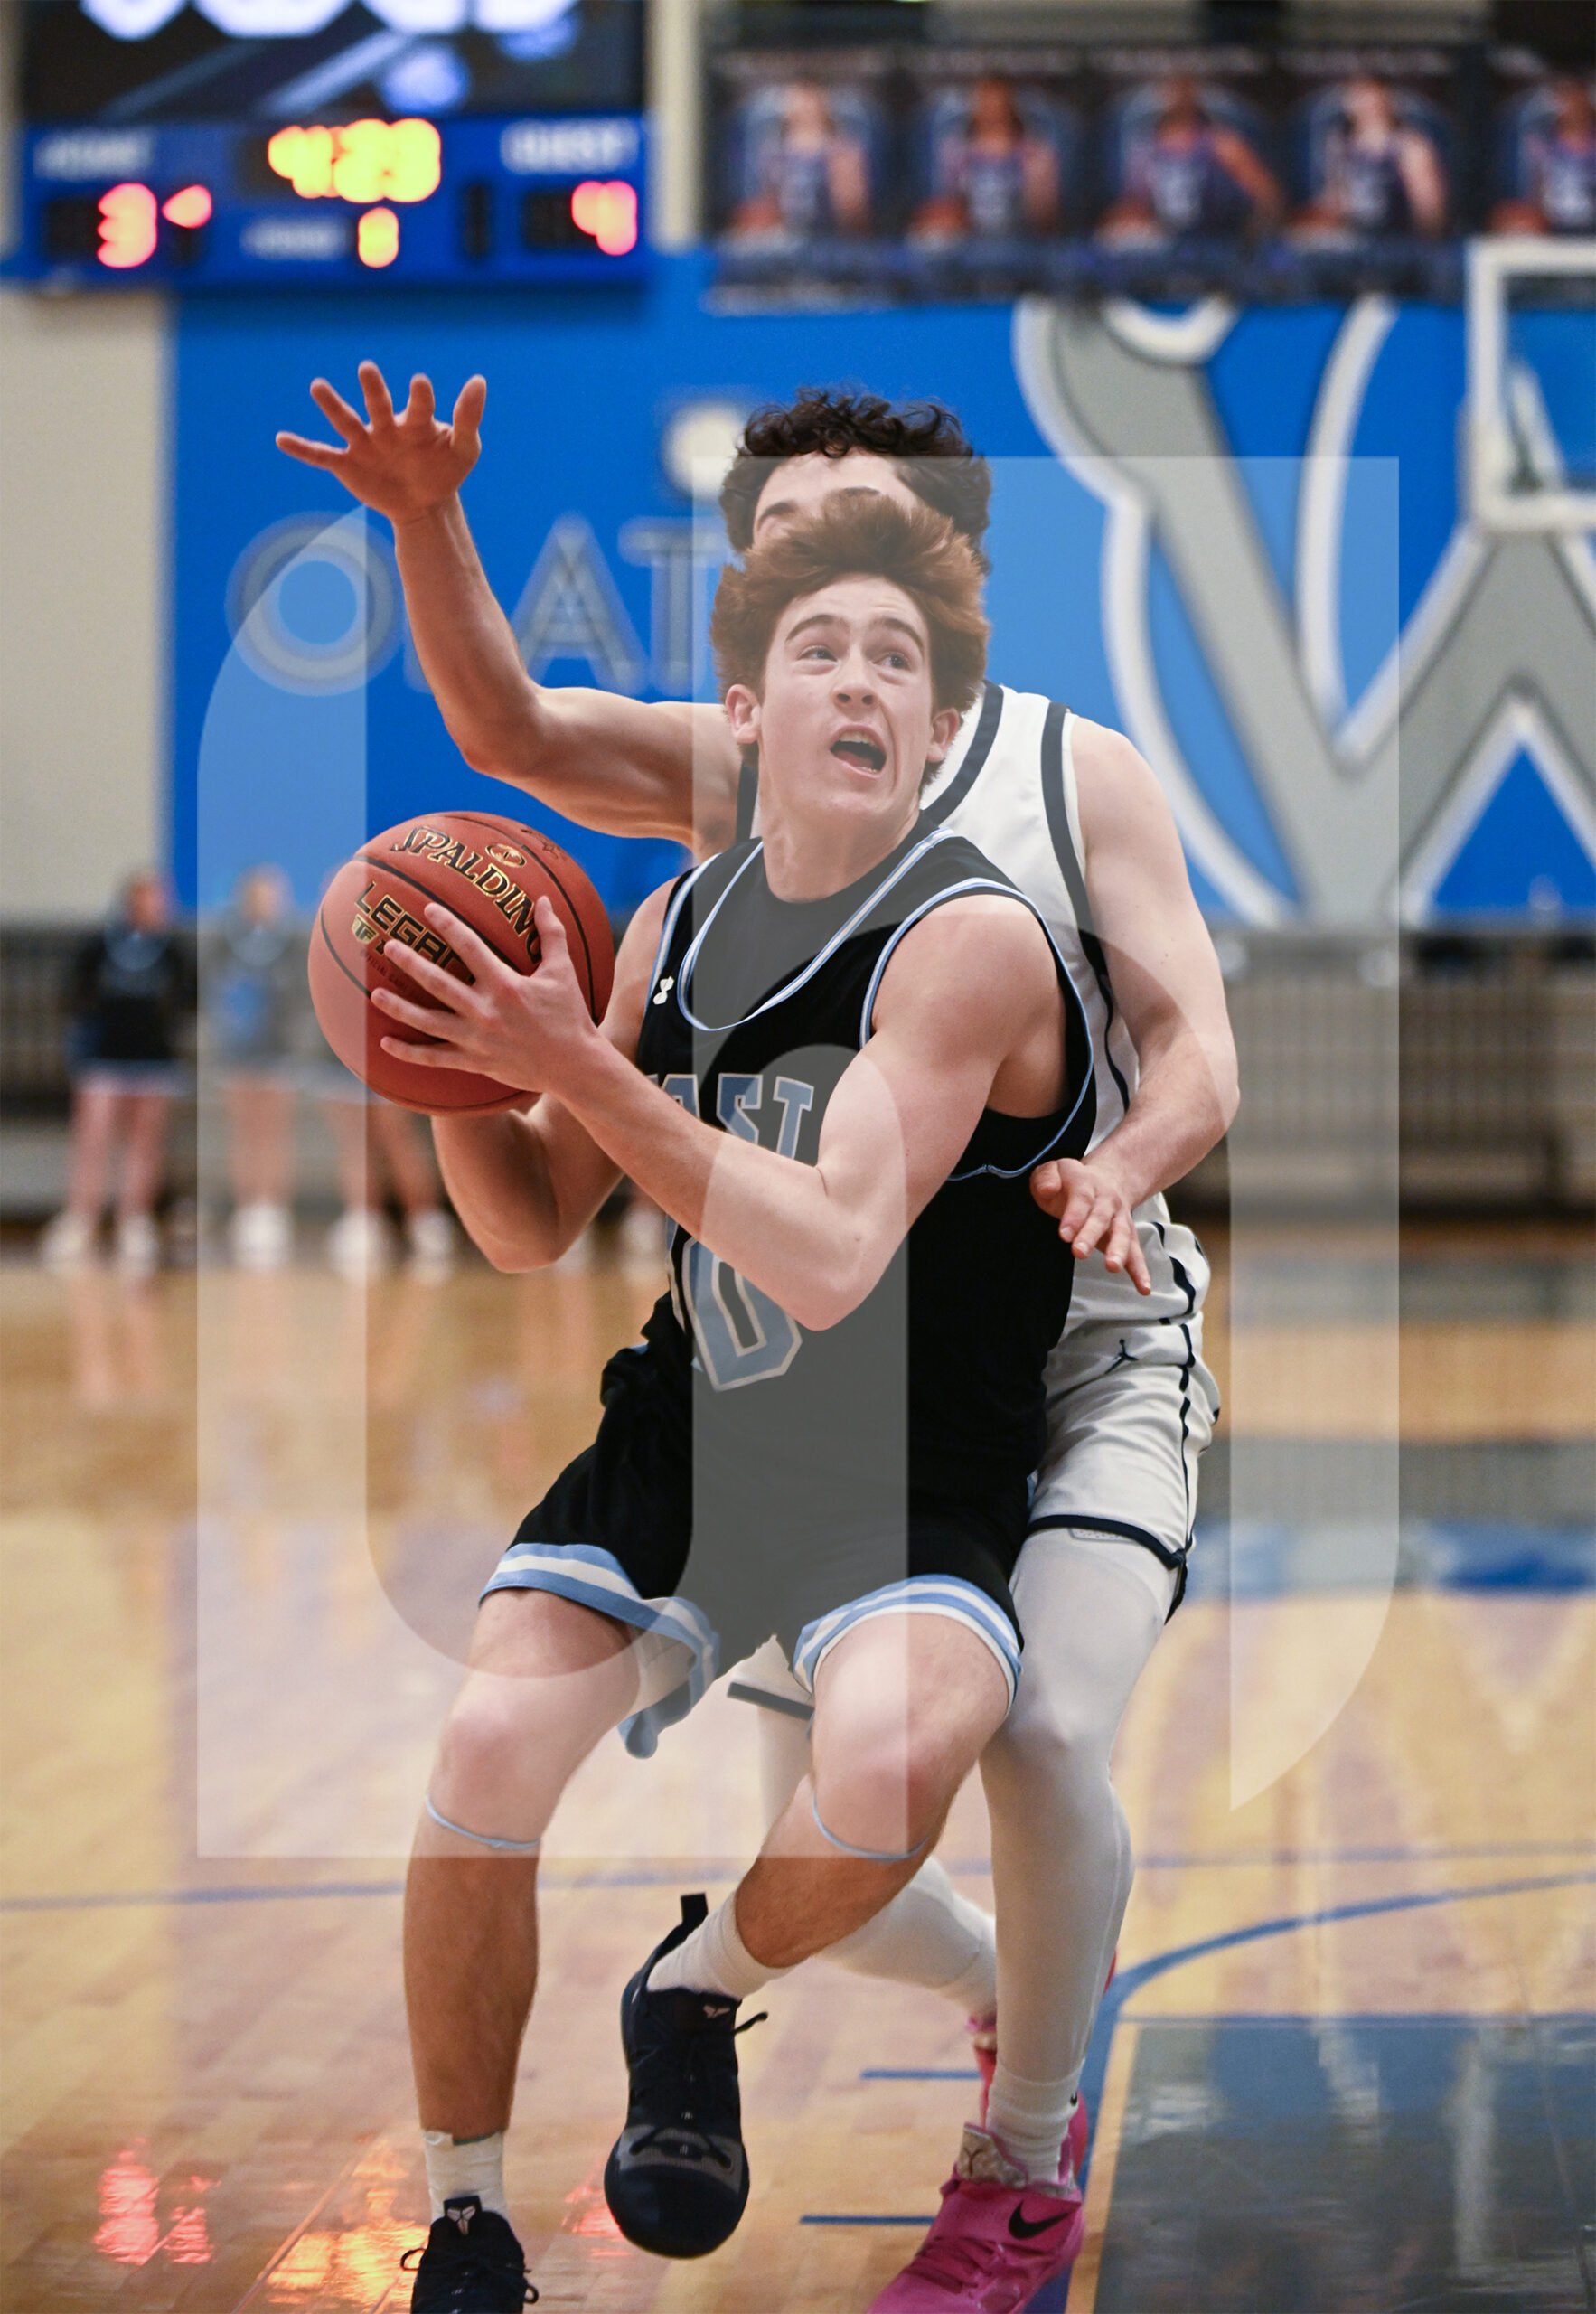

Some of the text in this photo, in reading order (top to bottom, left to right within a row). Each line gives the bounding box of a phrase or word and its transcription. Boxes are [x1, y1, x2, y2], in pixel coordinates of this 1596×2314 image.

[225, 511, 734, 696] OAT
[354, 881, 476, 987] LEGA
[645, 1072, 814, 1161] AST
[665, 1213, 803, 1393] 0
